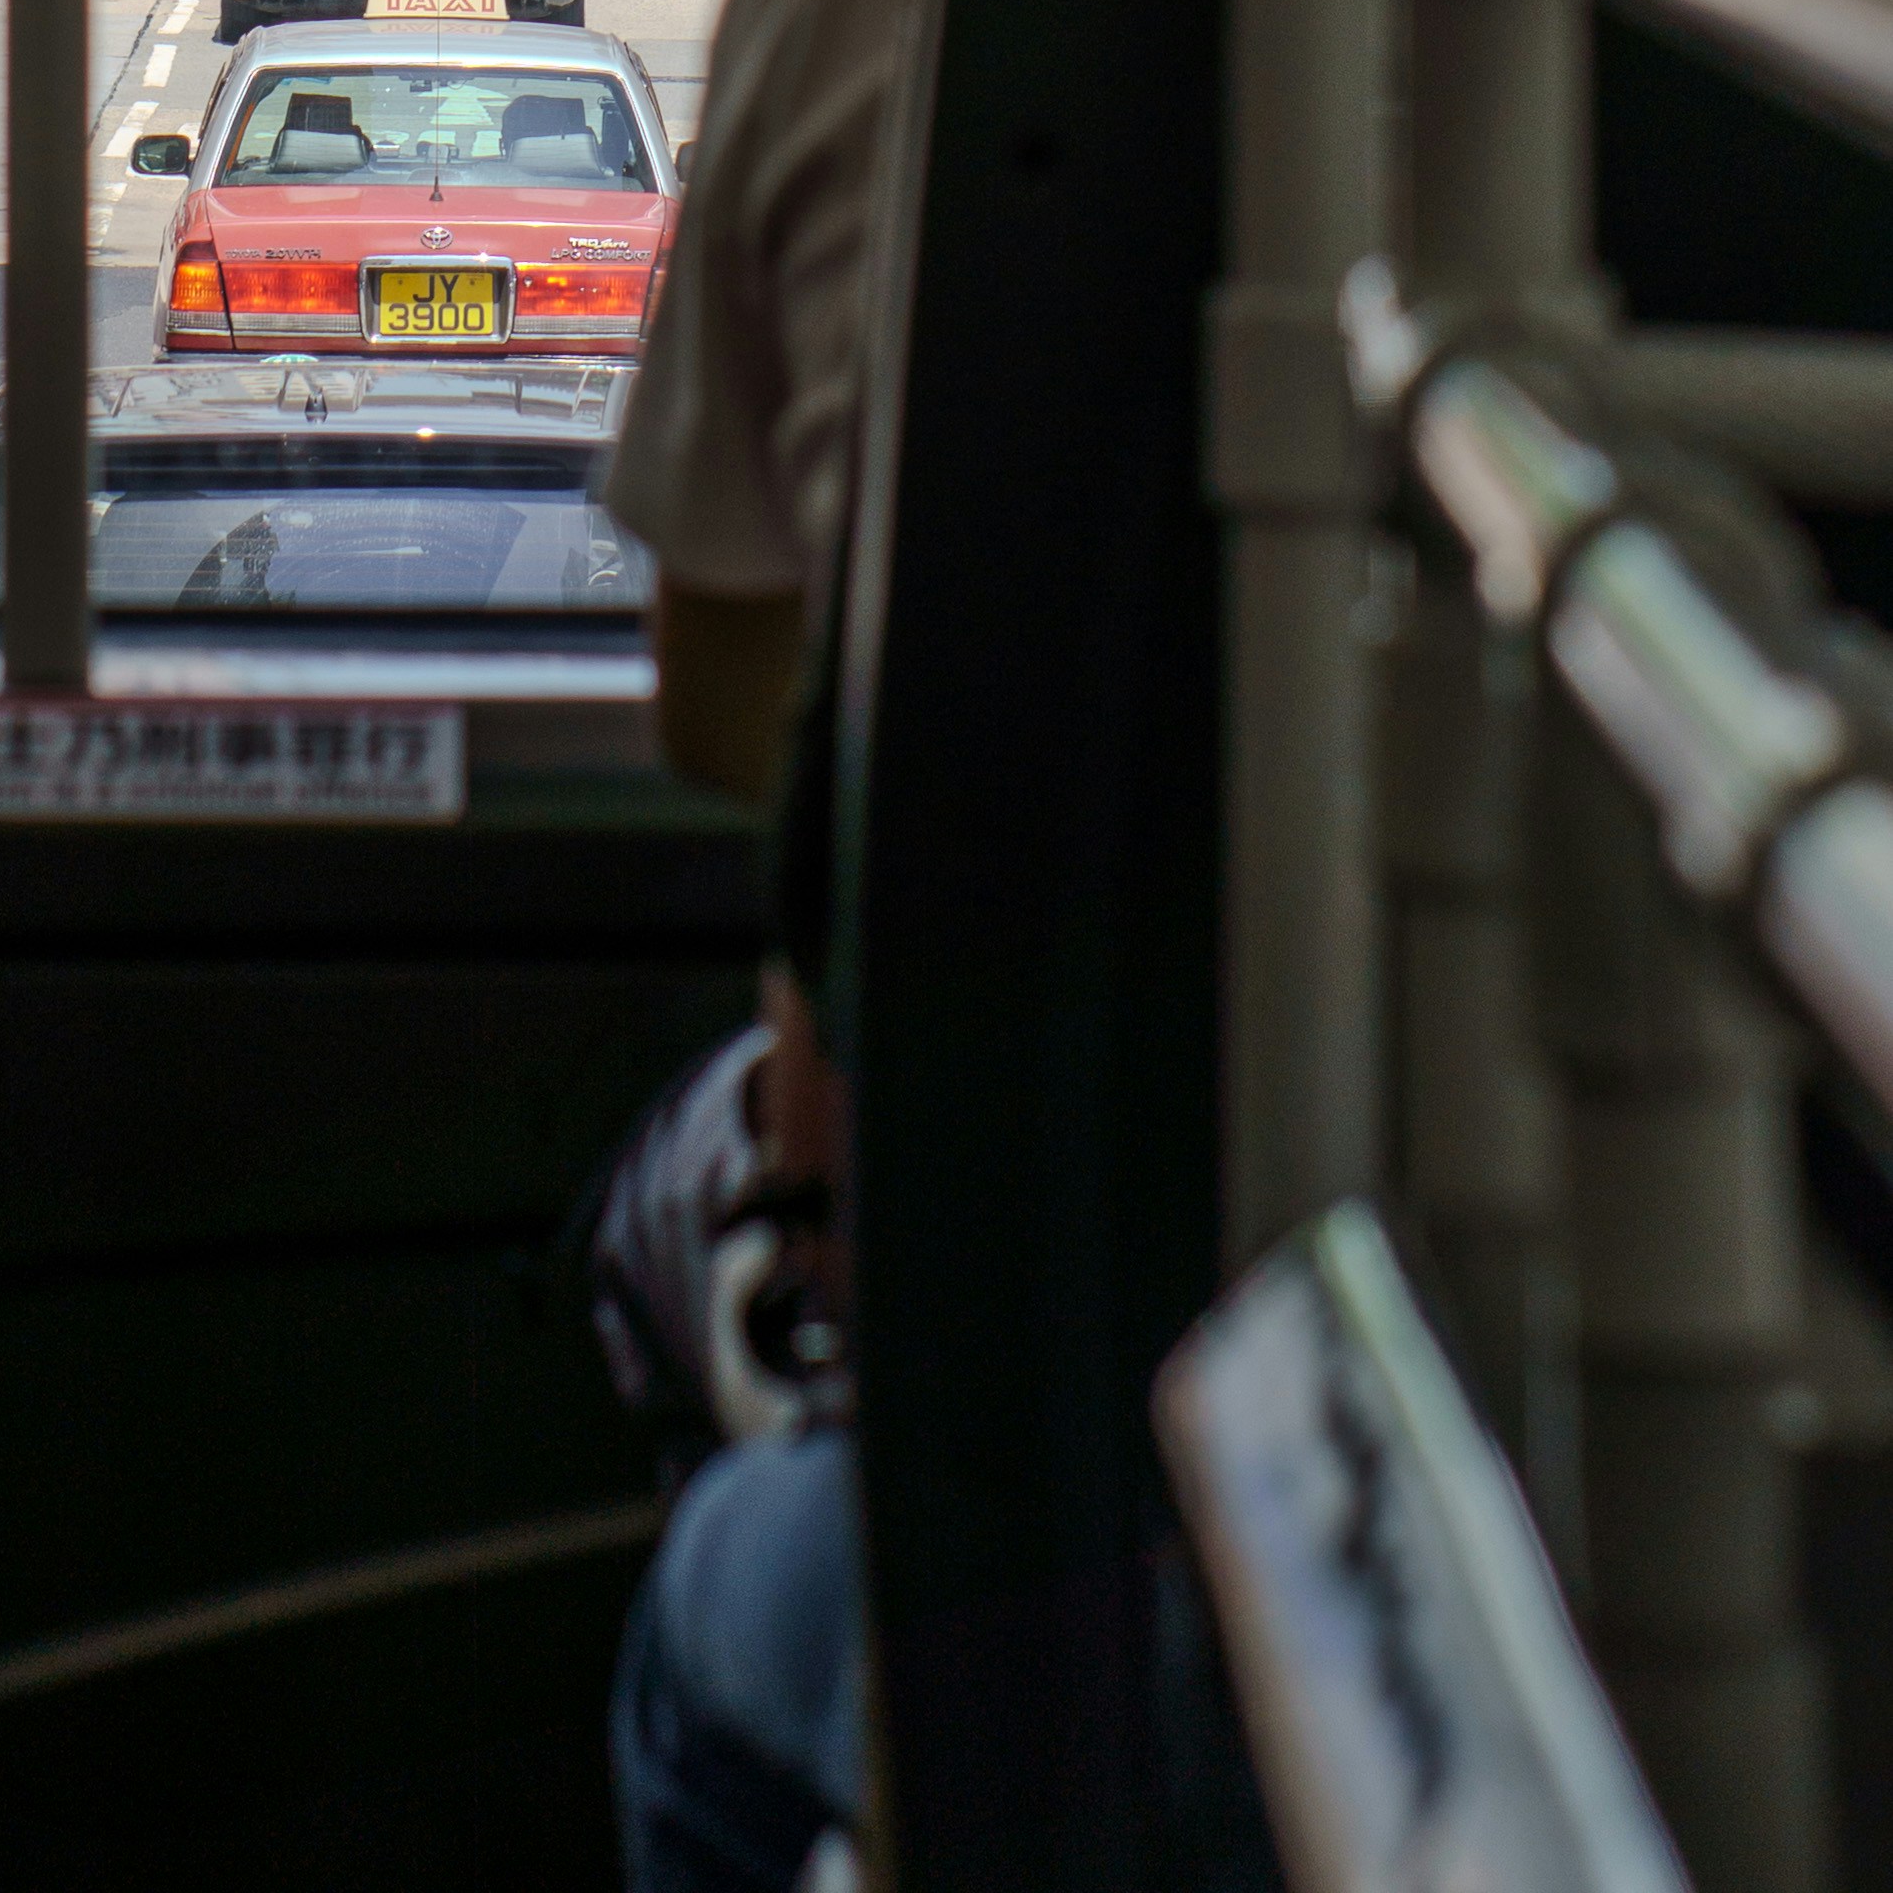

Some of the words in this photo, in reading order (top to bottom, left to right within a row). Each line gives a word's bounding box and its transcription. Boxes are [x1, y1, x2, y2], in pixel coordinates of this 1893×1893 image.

[550, 248, 581, 259] LPG
[584, 248, 652, 261] COMFORT
[412, 273, 460, 303] JY
[387, 302, 486, 332] 3900
